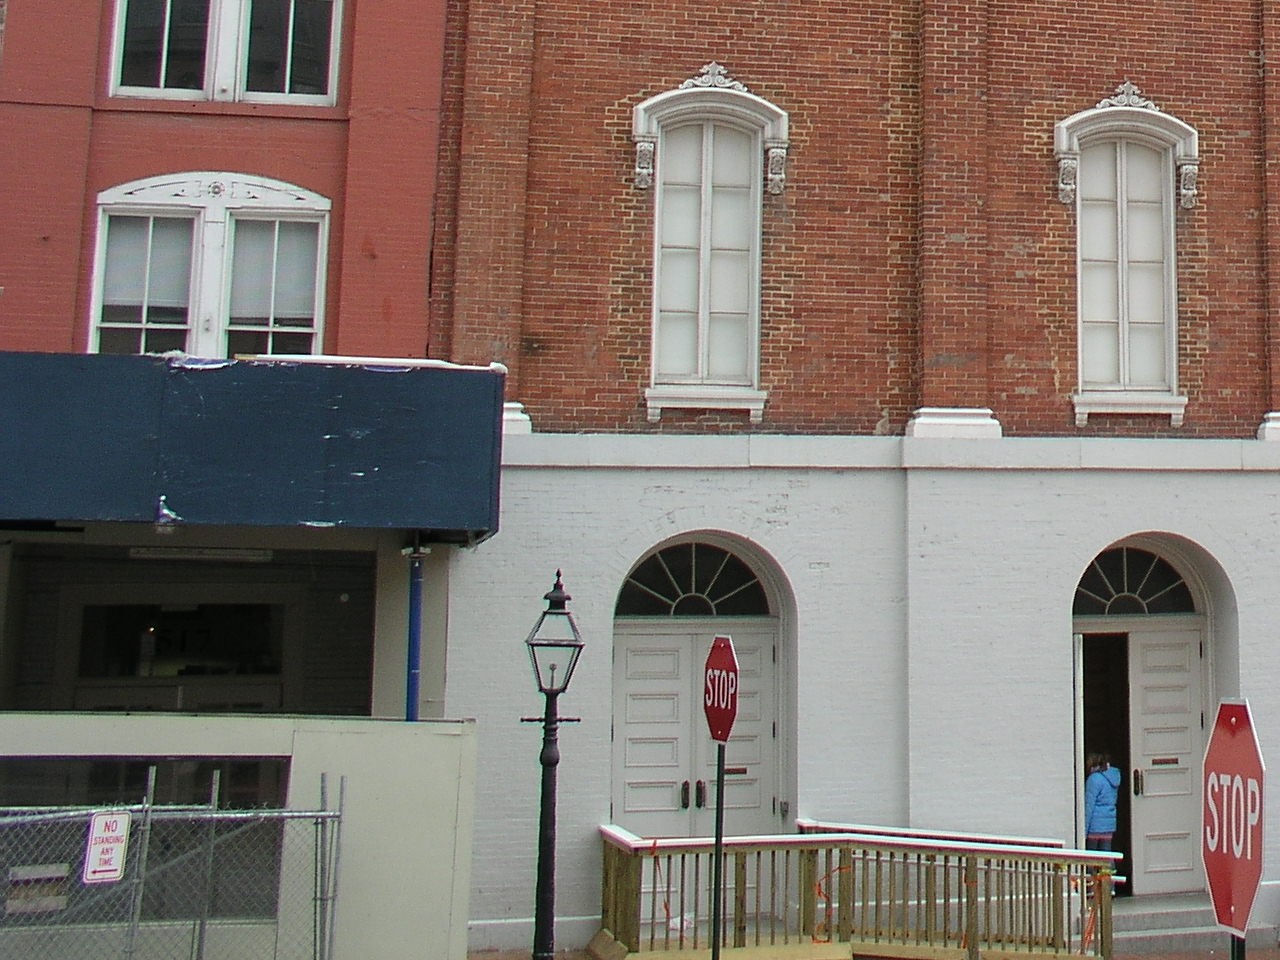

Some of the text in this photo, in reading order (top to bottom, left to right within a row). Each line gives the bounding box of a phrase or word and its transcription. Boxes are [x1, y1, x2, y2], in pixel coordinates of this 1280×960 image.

[705, 668, 736, 710] STOP
[1206, 771, 1260, 860] STOP
[103, 820, 118, 833] NO
[93, 835, 125, 845] STANDING
[100, 847, 114, 856] ANY
[98, 857, 114, 866] TIME
